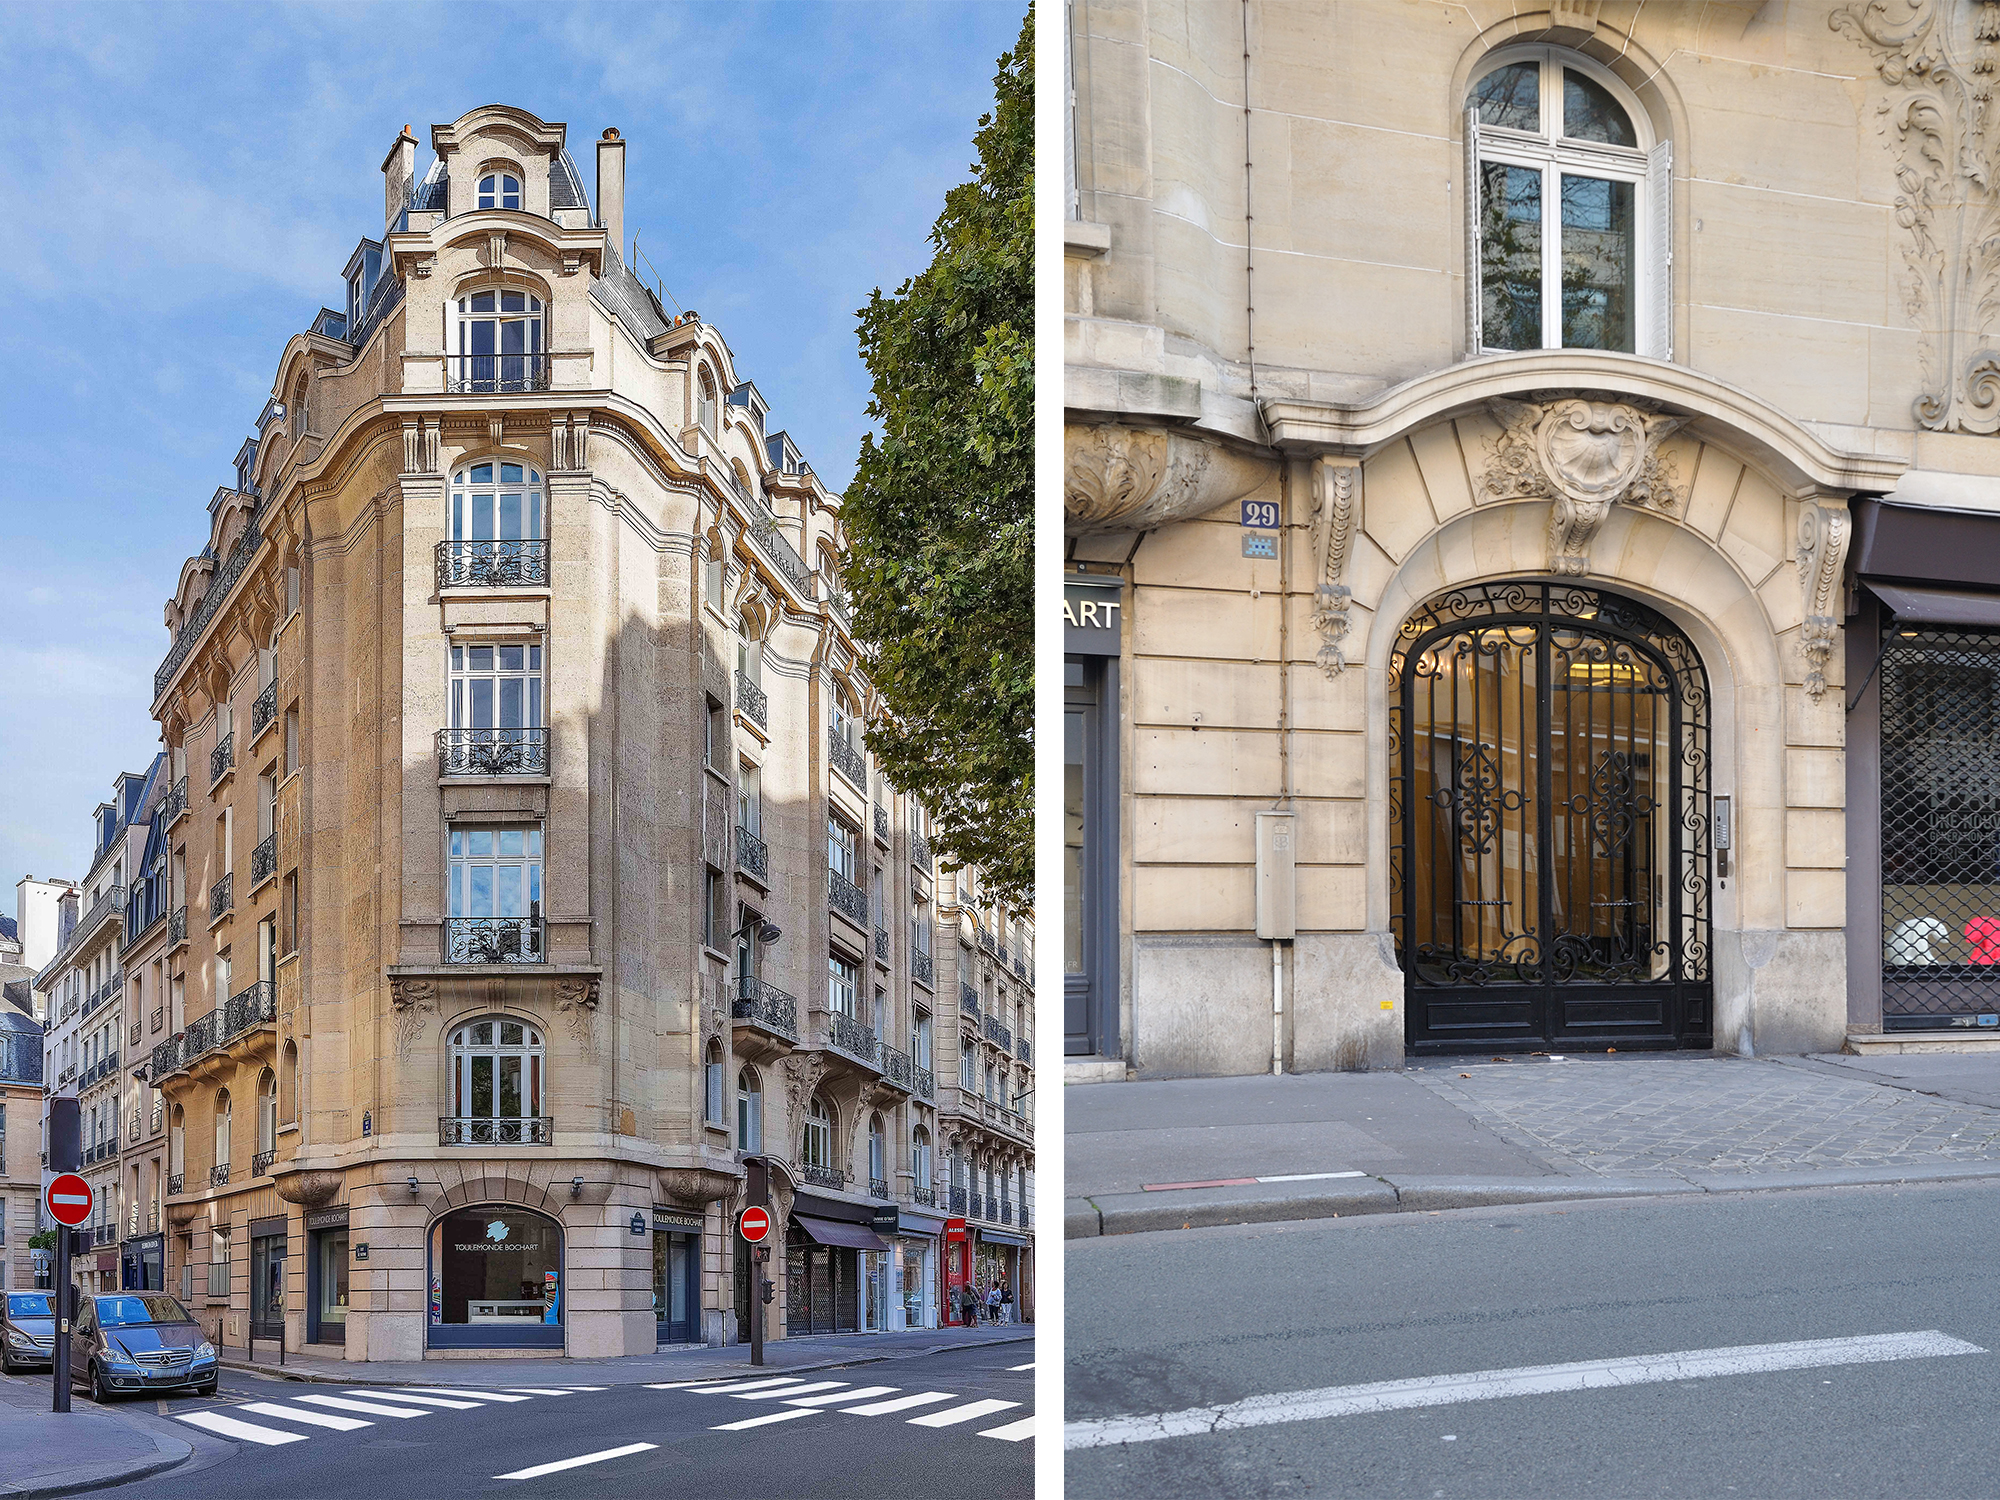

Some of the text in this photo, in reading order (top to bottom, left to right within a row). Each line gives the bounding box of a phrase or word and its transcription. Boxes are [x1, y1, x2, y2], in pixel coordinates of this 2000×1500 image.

[1246, 503, 1275, 526] 29
[1064, 599, 1120, 629] ART
[1930, 847, 1965, 860] PARIS
[653, 1213, 683, 1226] TOULEMONDE
[454, 1243, 539, 1251] TOULEMONDE BOCHART
